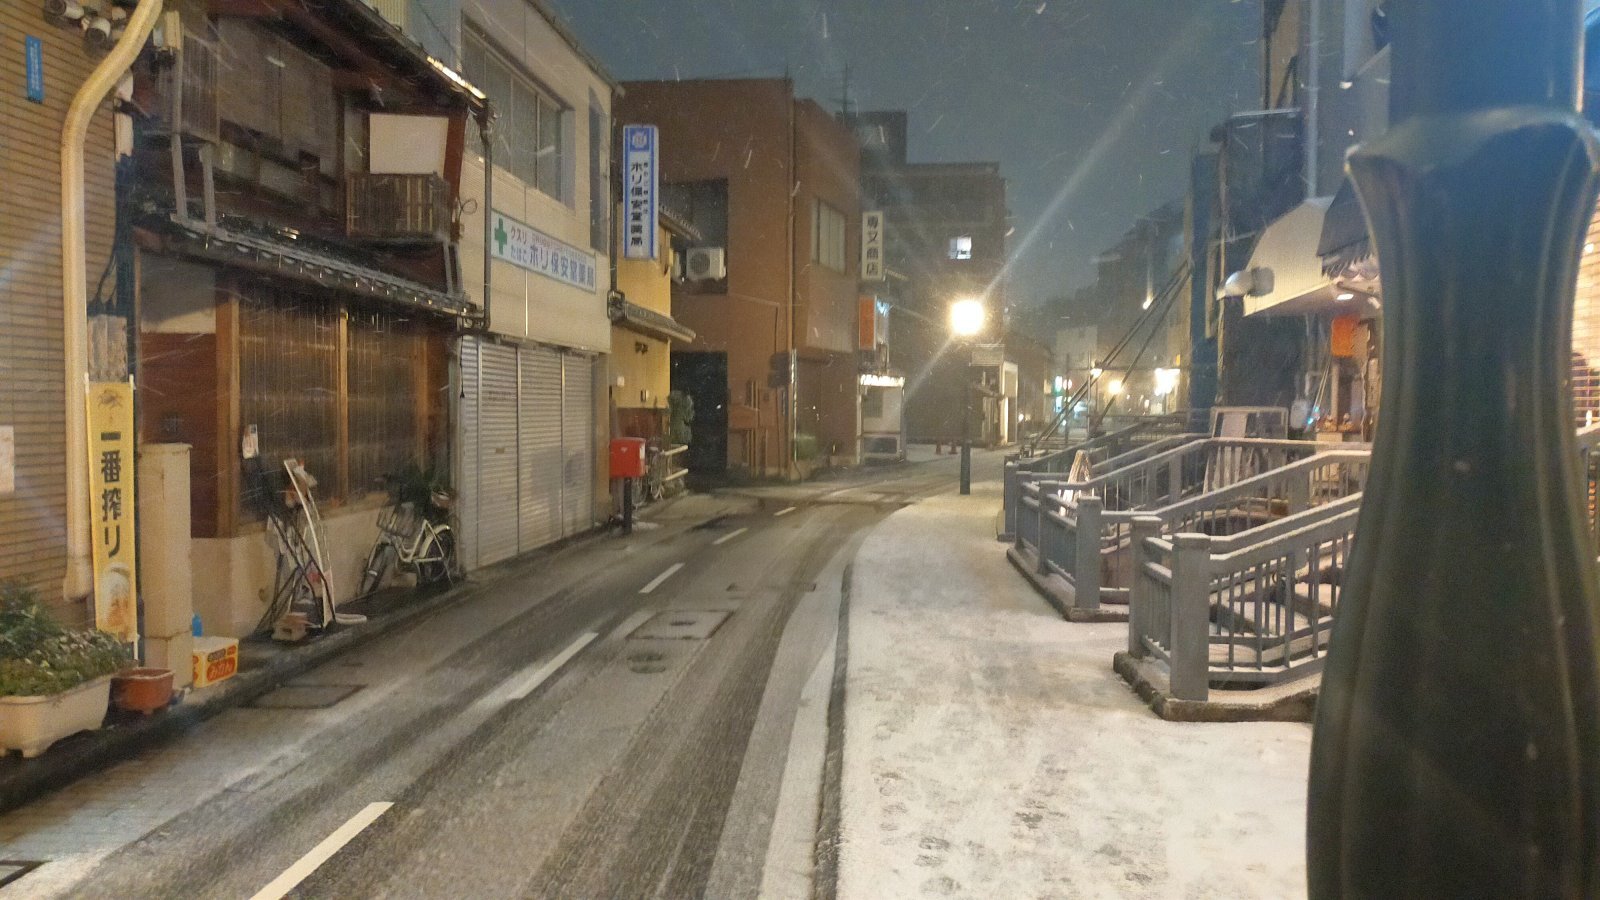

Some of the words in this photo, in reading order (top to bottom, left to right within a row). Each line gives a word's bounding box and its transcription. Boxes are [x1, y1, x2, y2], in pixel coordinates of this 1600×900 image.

[510, 226, 527, 245] クスリ
[510, 245, 528, 263] たばこ
[530, 244, 594, 289] ホリ保安堂薬局
[100, 431, 122, 558] 一番搾り
